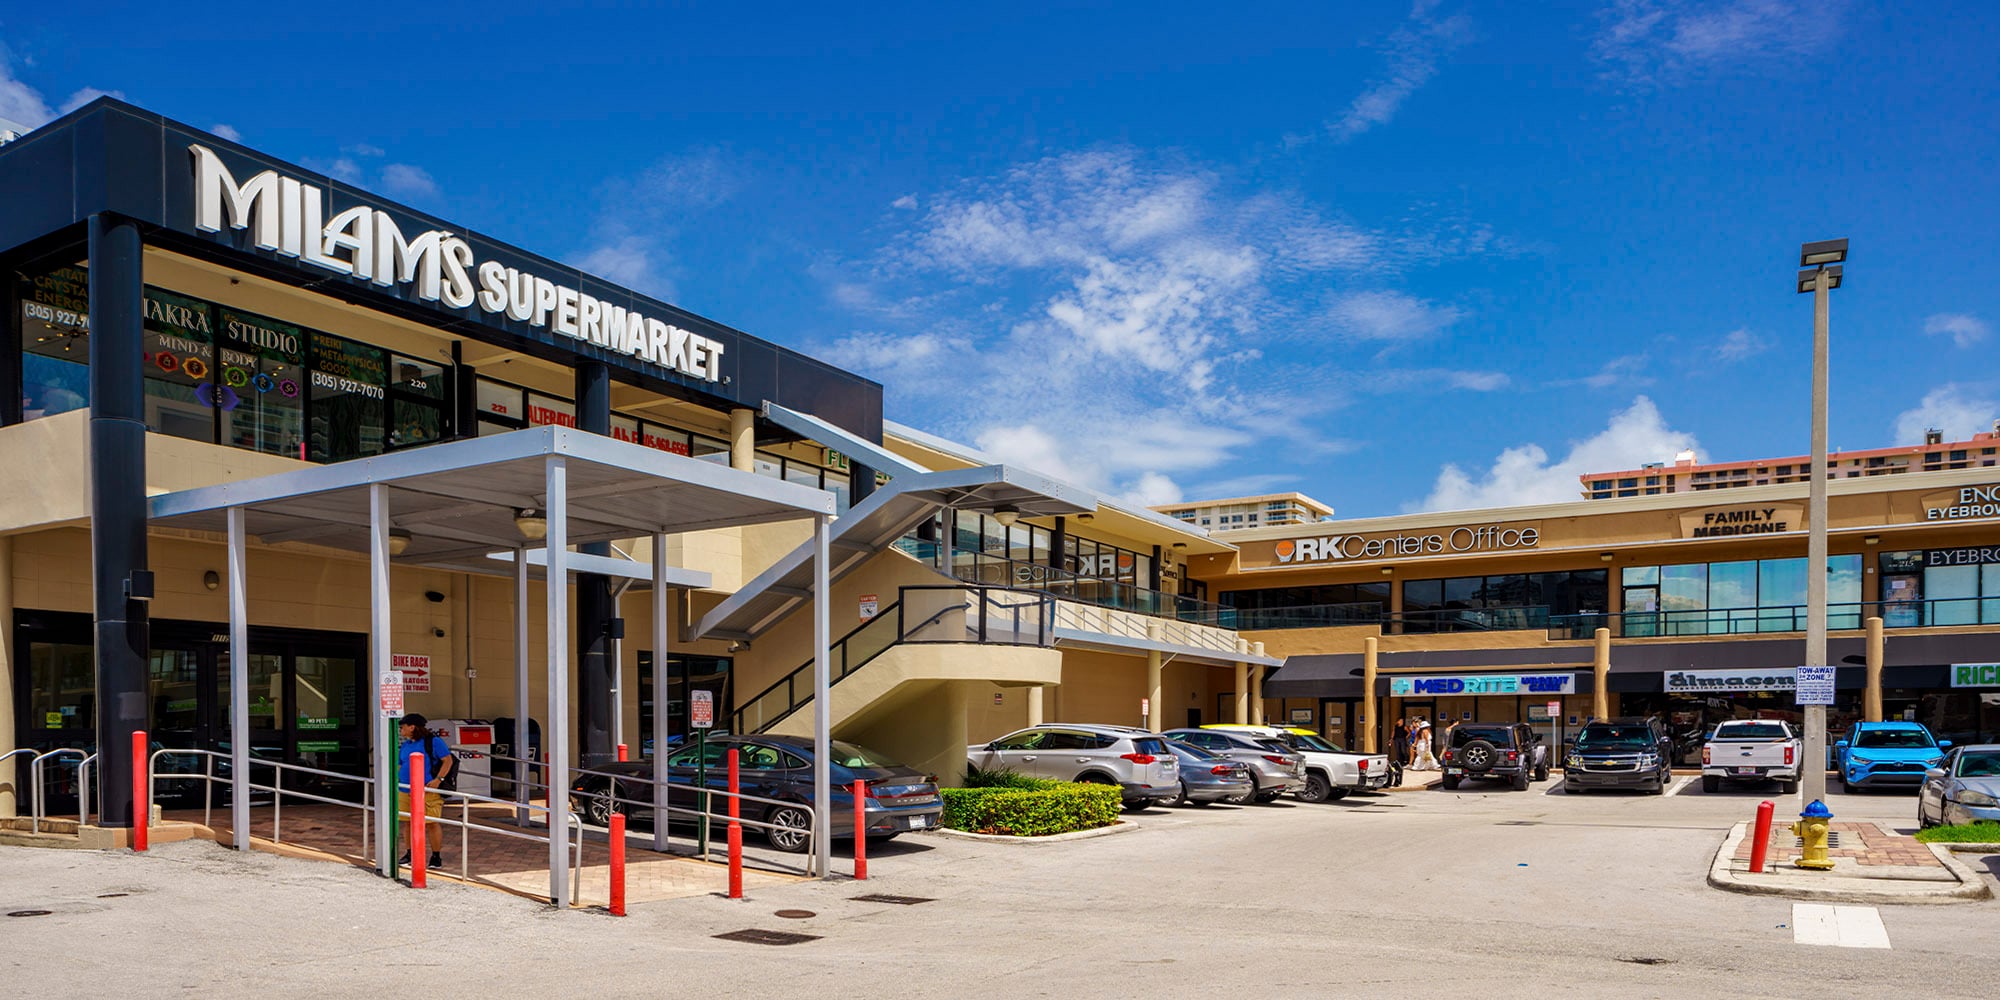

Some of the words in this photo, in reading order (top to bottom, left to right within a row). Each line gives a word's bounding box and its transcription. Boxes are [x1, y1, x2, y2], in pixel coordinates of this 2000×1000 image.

[188, 143, 475, 309] MILAM'S
[478, 260, 724, 382] SUPERMARKET
[34, 275, 89, 299] CRYSTA
[24, 302, 54, 323] (305)
[143, 298, 210, 333] AKRA
[228, 320, 298, 355] STUDIO
[159, 334, 198, 353] MIND
[201, 345, 212, 358] &
[320, 336, 342, 350] REIKI
[222, 349, 257, 369] BODY
[320, 350, 383, 371] METAPHYSICAL
[320, 361, 351, 376] GOODS
[311, 372, 337, 391] (305)
[340, 378, 384, 400] 927-7070
[410, 378, 427, 390] 220
[491, 403, 507, 414] 221
[828, 450, 850, 469] FL
[1704, 508, 1775, 524] FAMILY
[1449, 526, 1538, 551] Office
[1693, 522, 1786, 537] MEDICINE
[393, 655, 409, 667] BIKE
[410, 656, 428, 668] RACK
[1956, 665, 2000, 686] RIC
[429, 728, 450, 737] edEx
[458, 750, 483, 759] FedEx
